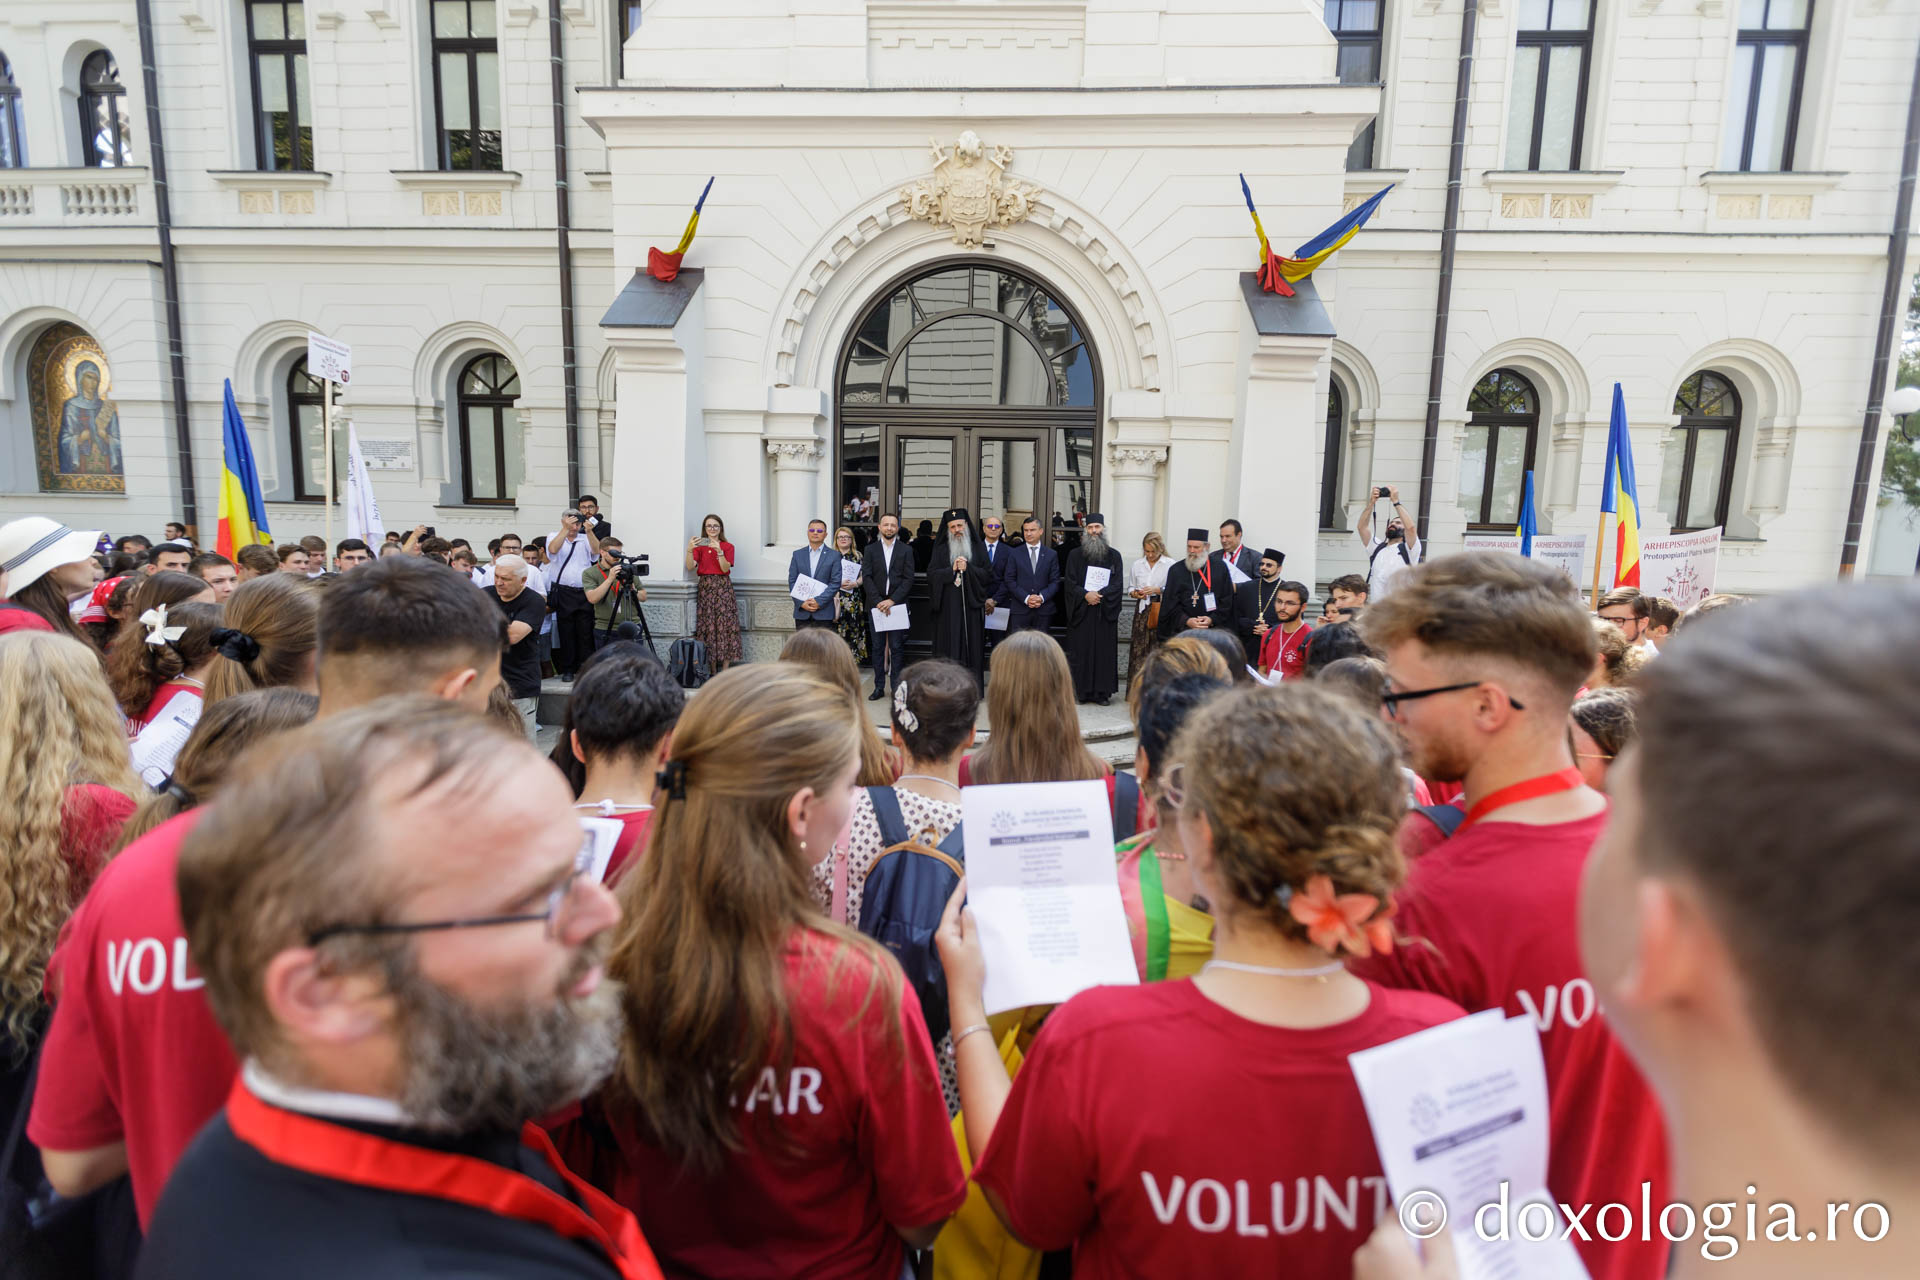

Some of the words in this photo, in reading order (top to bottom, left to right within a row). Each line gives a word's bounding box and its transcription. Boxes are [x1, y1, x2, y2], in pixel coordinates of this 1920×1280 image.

[1644, 537, 1699, 551] ARHIEPISCOPIA
[1644, 551, 1689, 560] Protopopiatul
[107, 936, 206, 996] VOL
[1515, 978, 1605, 1032] VO
[729, 1066, 824, 1115] AR
[1140, 1170, 1389, 1238] VOLUNT
